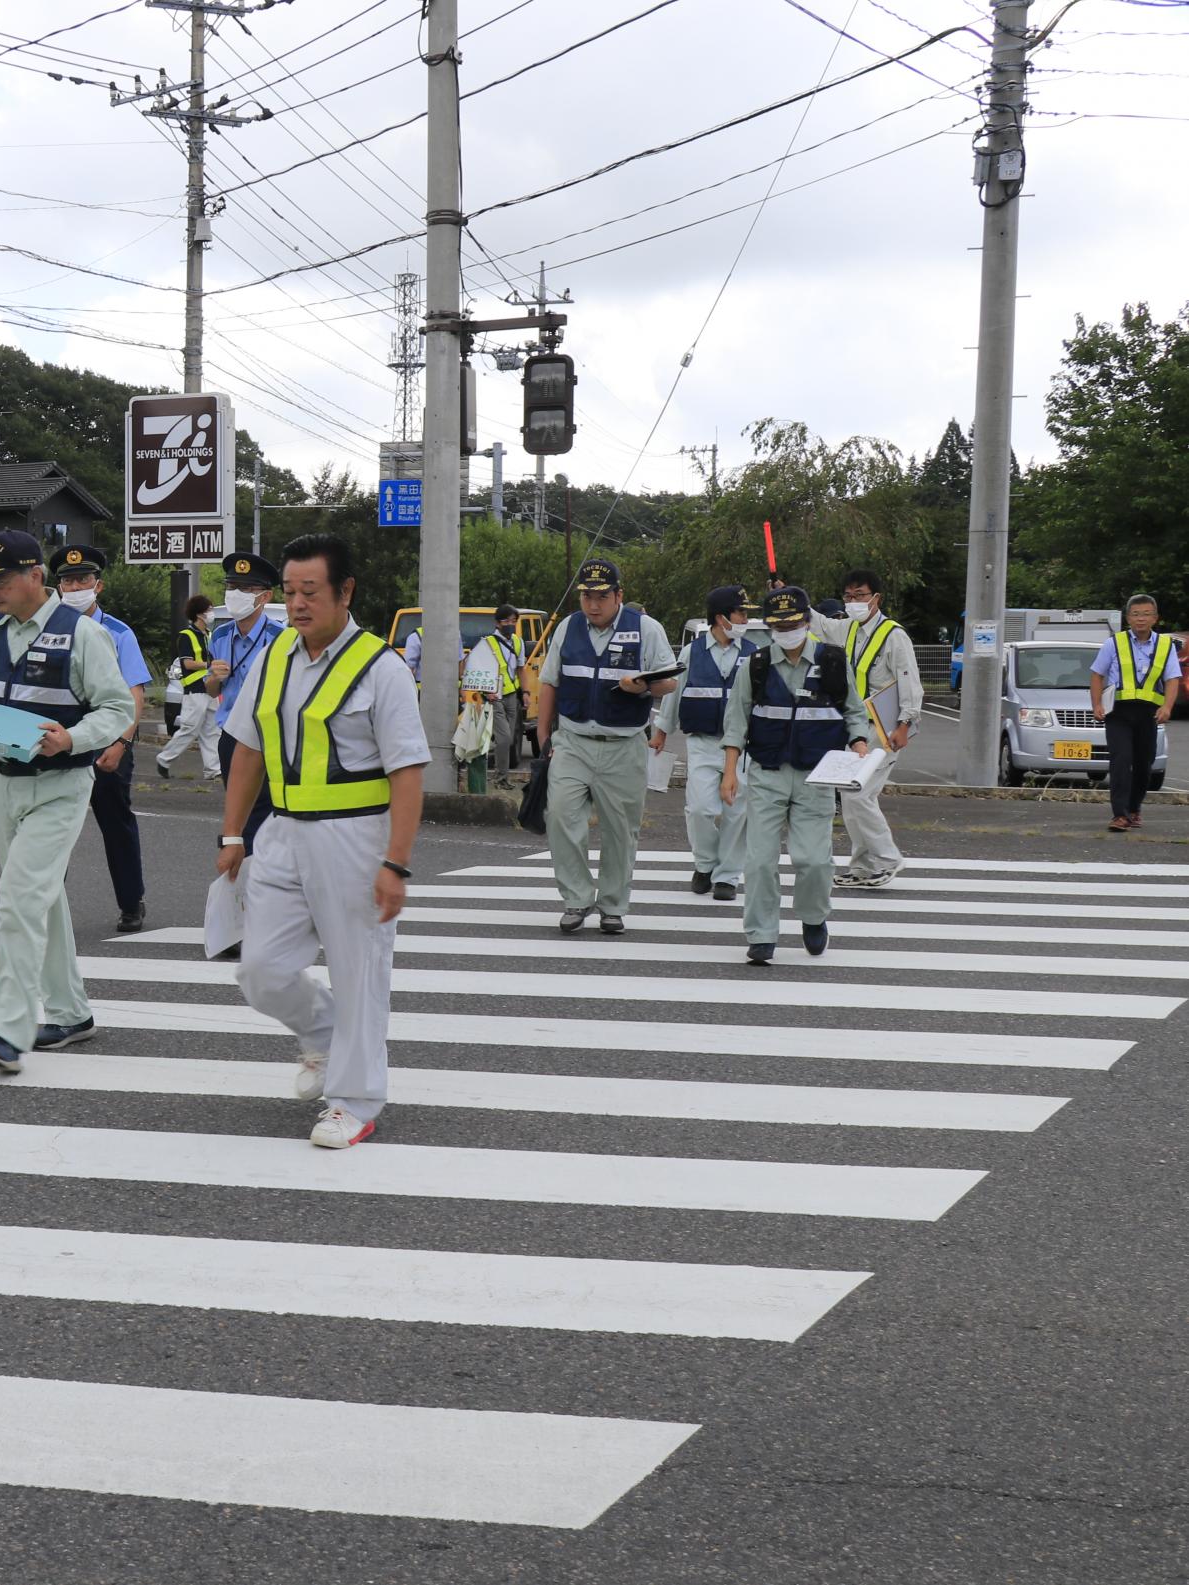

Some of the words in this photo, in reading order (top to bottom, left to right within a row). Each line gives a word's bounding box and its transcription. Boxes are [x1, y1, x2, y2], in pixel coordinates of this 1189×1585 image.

[171, 447, 213, 458] HOLDINGS
[398, 484, 422, 495] 黒田
[130, 532, 158, 554] たばこ
[166, 531, 186, 554] 酒
[194, 531, 222, 553] ATM
